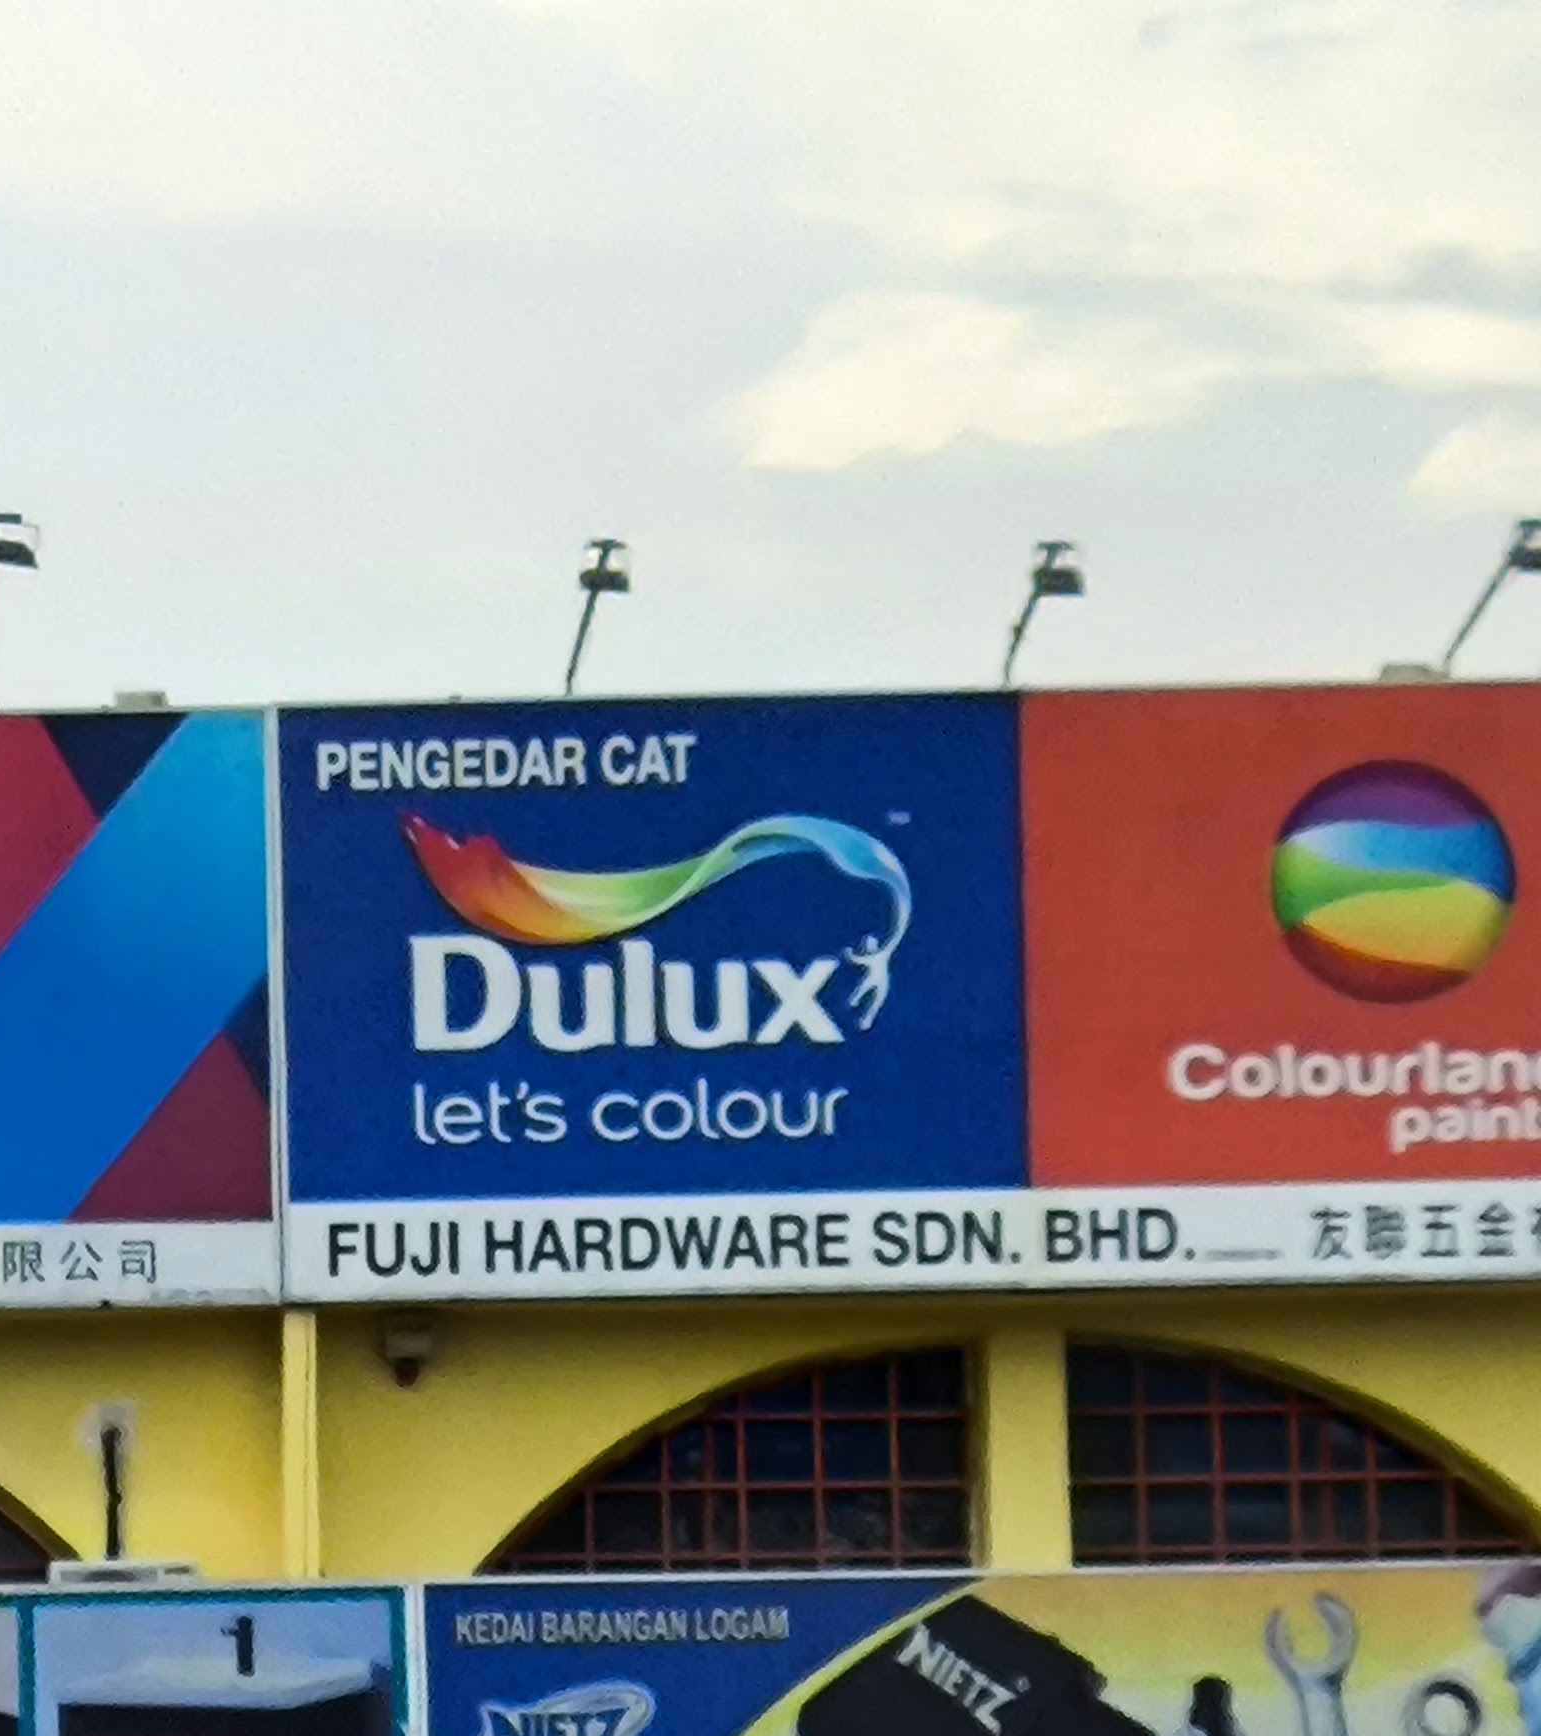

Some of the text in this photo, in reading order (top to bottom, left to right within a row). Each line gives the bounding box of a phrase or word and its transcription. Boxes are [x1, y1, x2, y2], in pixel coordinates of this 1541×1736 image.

[316, 735, 698, 791] PENGEDAR CAT
[409, 935, 845, 1051] Dulux
[413, 1077, 849, 1145] let's colour
[328, 1221, 461, 1278] FUJI
[484, 1212, 849, 1273] HARDWARE
[872, 1210, 1021, 1266] SDN.
[1044, 1207, 1196, 1263] BHD.
[455, 1606, 790, 1644] KEDAI BARANGAN LOGAM
[896, 1622, 1017, 1736] NIETZ
